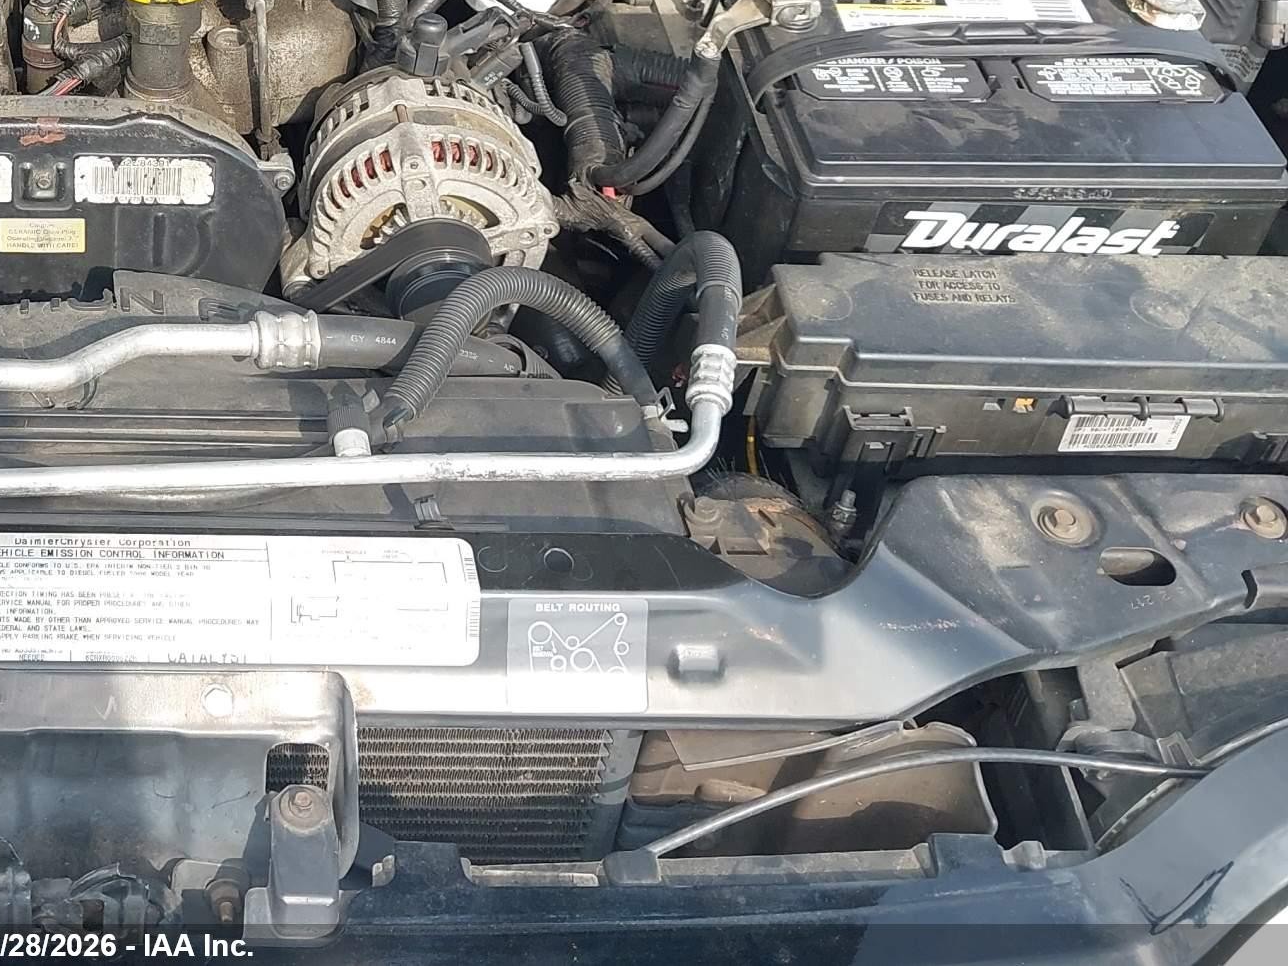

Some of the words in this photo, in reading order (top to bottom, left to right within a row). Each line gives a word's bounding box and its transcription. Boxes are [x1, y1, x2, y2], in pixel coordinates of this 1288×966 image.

[902, 210, 1178, 256] Duralast
[913, 268, 959, 278] RELEASE
[962, 270, 996, 279] LATCH
[918, 280, 940, 290] FOR
[942, 281, 984, 290] ACCESS
[988, 282, 1000, 291] TO
[914, 292, 948, 302] FUSES
[952, 294, 972, 302] AND
[975, 294, 1016, 303] RELAYS
[375, 336, 397, 346] 4844
[40, 549, 92, 558] EMISSION
[99, 550, 144, 558] CONTROL
[154, 550, 224, 560] INFORMATION
[536, 603, 563, 612] BELT
[568, 603, 620, 612] ROUTING
[14, 616, 32, 624] MADE
